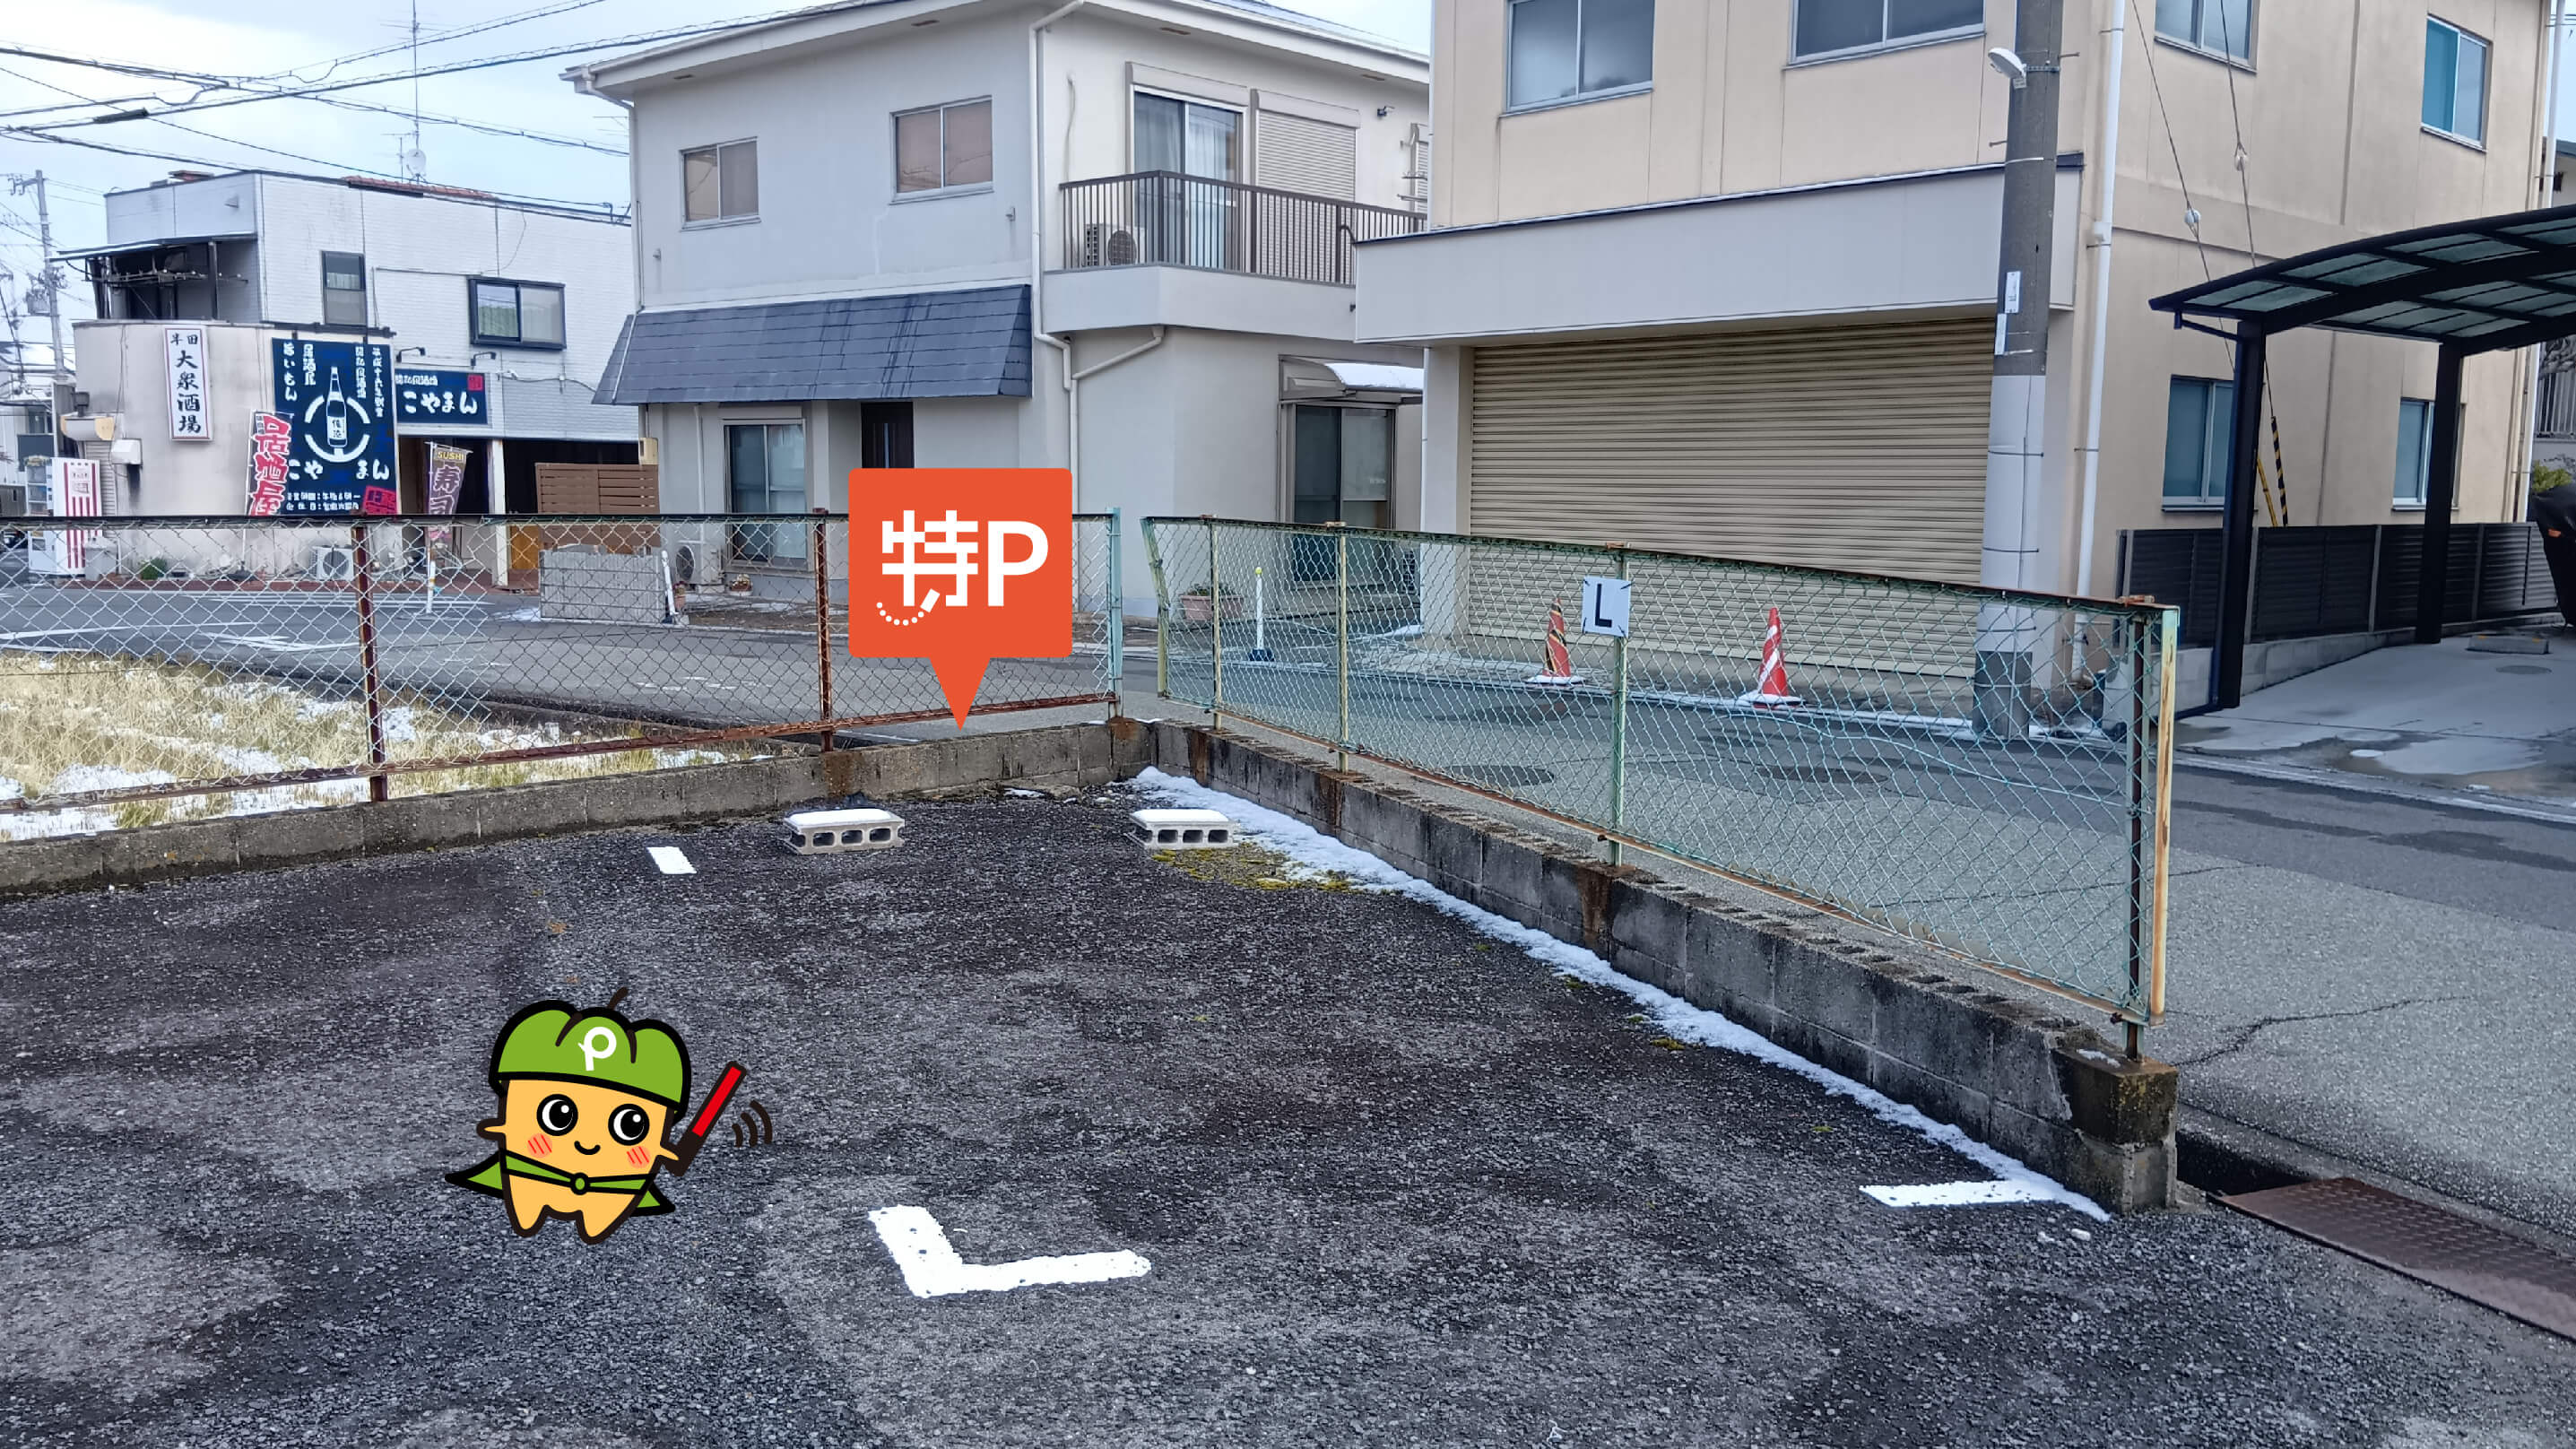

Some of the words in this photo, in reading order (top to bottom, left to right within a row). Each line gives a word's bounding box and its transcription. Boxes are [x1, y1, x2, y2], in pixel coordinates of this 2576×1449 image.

[170, 333, 198, 346] 半田
[282, 342, 298, 402] 旨いもん
[175, 350, 202, 433] 大衆酒場
[403, 390, 478, 414] こやまん
[437, 451, 464, 461] SUSHI
[1595, 583, 1612, 628] L
